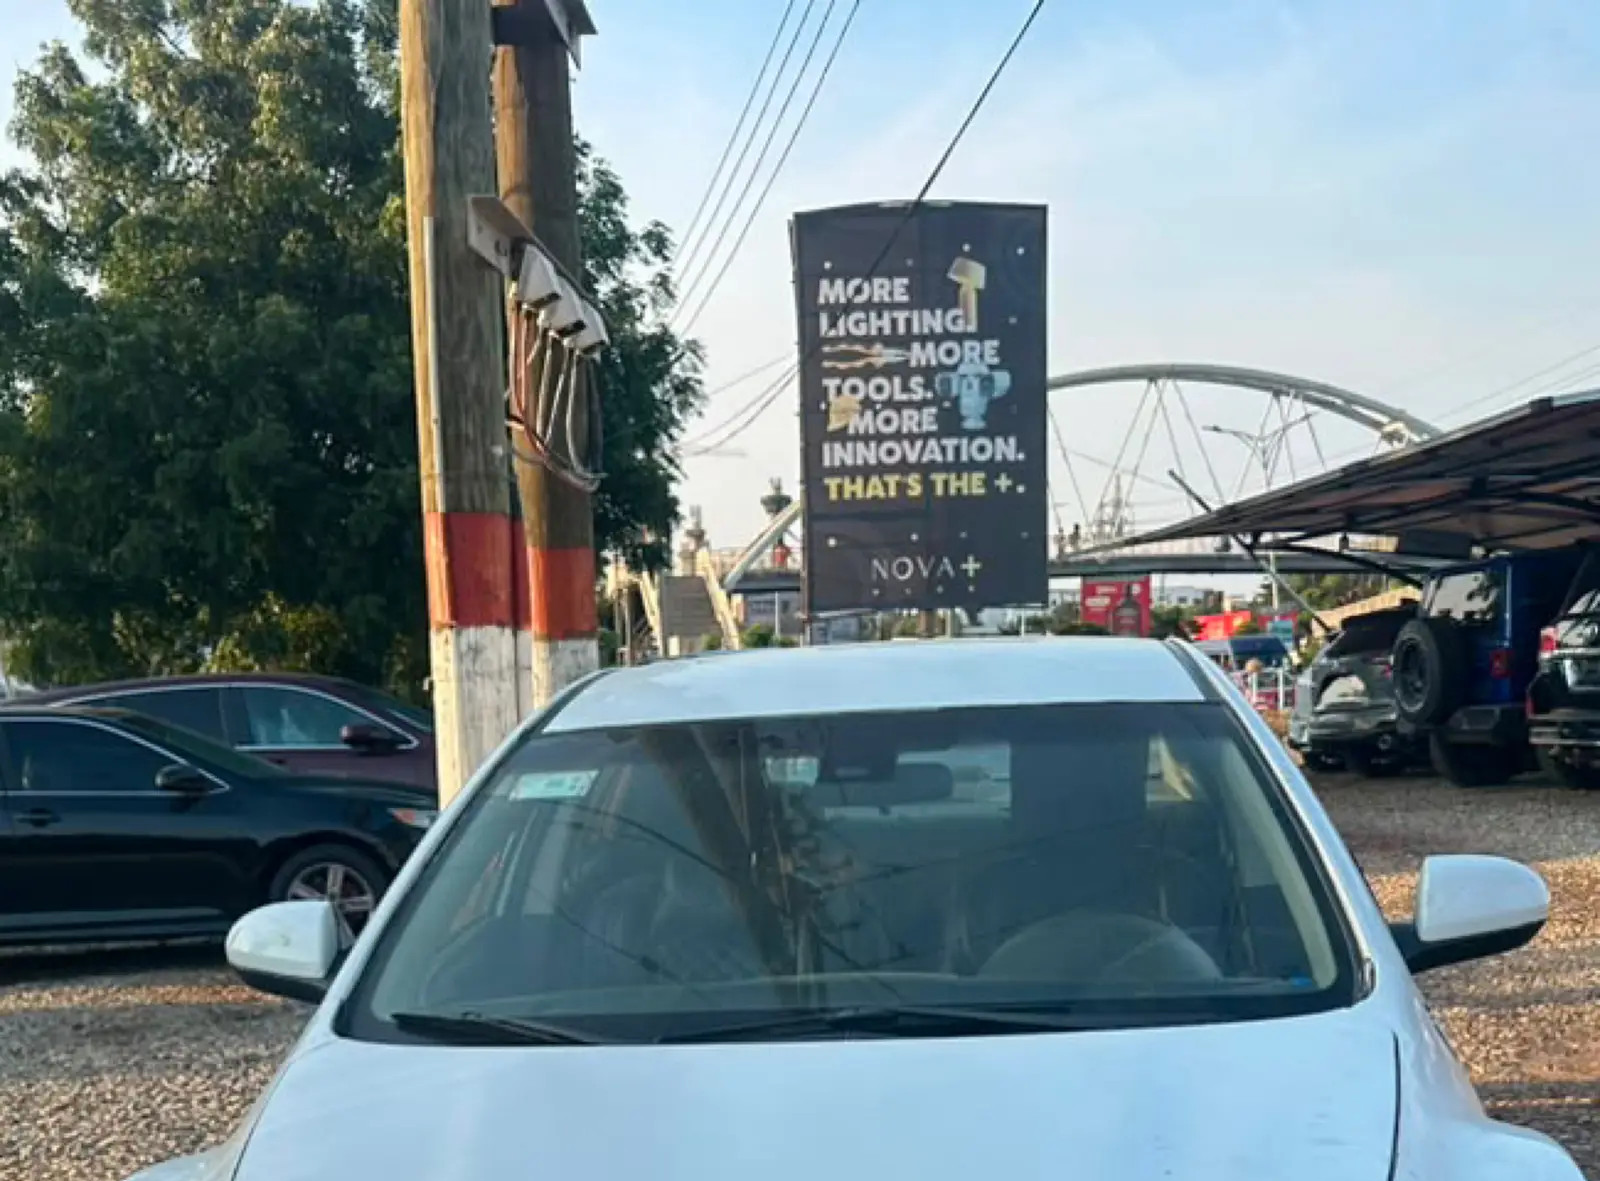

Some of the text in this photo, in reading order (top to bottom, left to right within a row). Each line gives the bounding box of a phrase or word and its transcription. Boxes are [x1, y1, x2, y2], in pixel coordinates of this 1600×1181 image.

[818, 277, 910, 304] MORE
[909, 339, 1001, 367] MORE
[821, 376, 934, 401] TOOLS.
[847, 406, 939, 435] MORE
[821, 435, 1026, 467] INNOVATION.
[823, 472, 924, 501] THAT'S
[930, 471, 986, 496] THE
